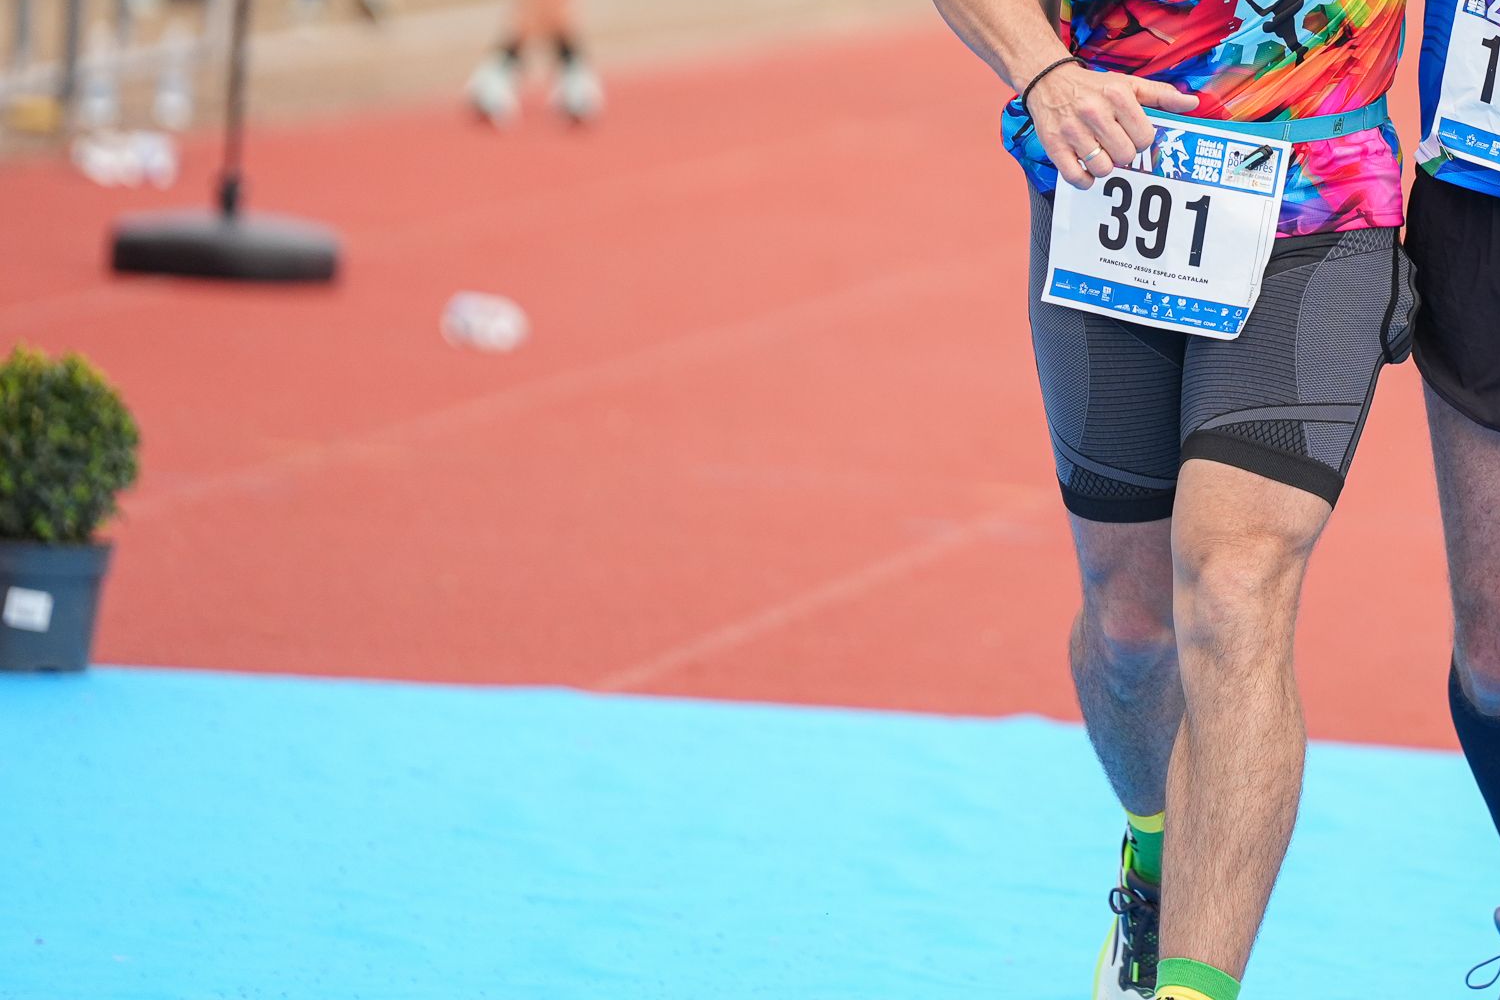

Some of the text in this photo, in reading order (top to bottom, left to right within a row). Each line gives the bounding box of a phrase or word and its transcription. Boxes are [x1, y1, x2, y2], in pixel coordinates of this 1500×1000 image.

[1196, 145, 1222, 159] LUCENA
[1191, 164, 1220, 183] 2026
[1099, 176, 1211, 268] 391
[1099, 258, 1132, 269] FRANCISCO
[1153, 269, 1176, 279] ESPEJO
